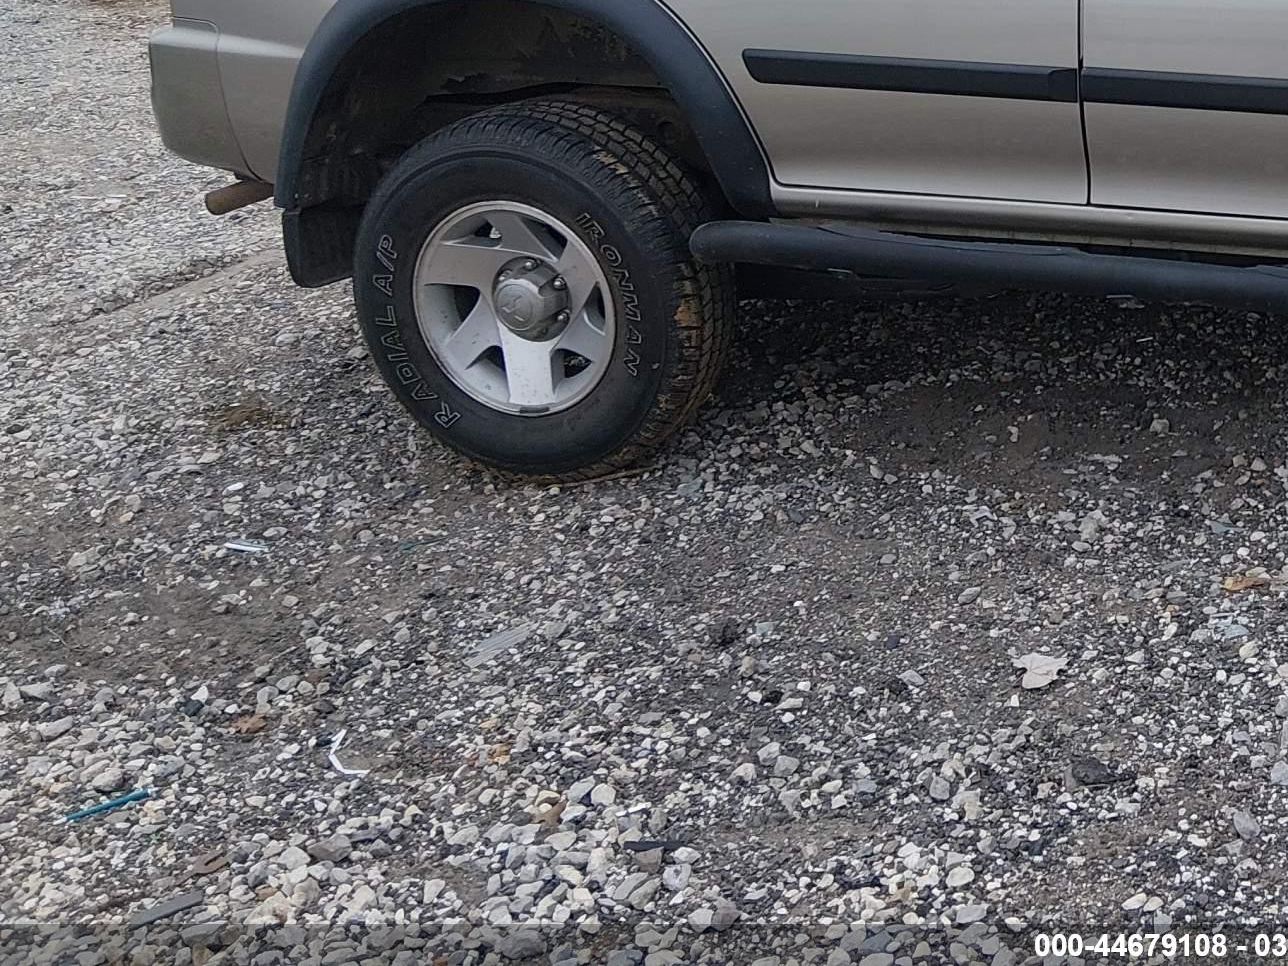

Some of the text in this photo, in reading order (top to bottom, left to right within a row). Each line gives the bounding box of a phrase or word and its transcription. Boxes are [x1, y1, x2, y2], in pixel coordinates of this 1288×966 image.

[372, 233, 460, 429] RADIAL A/P
[575, 212, 642, 377] IRONMAN
